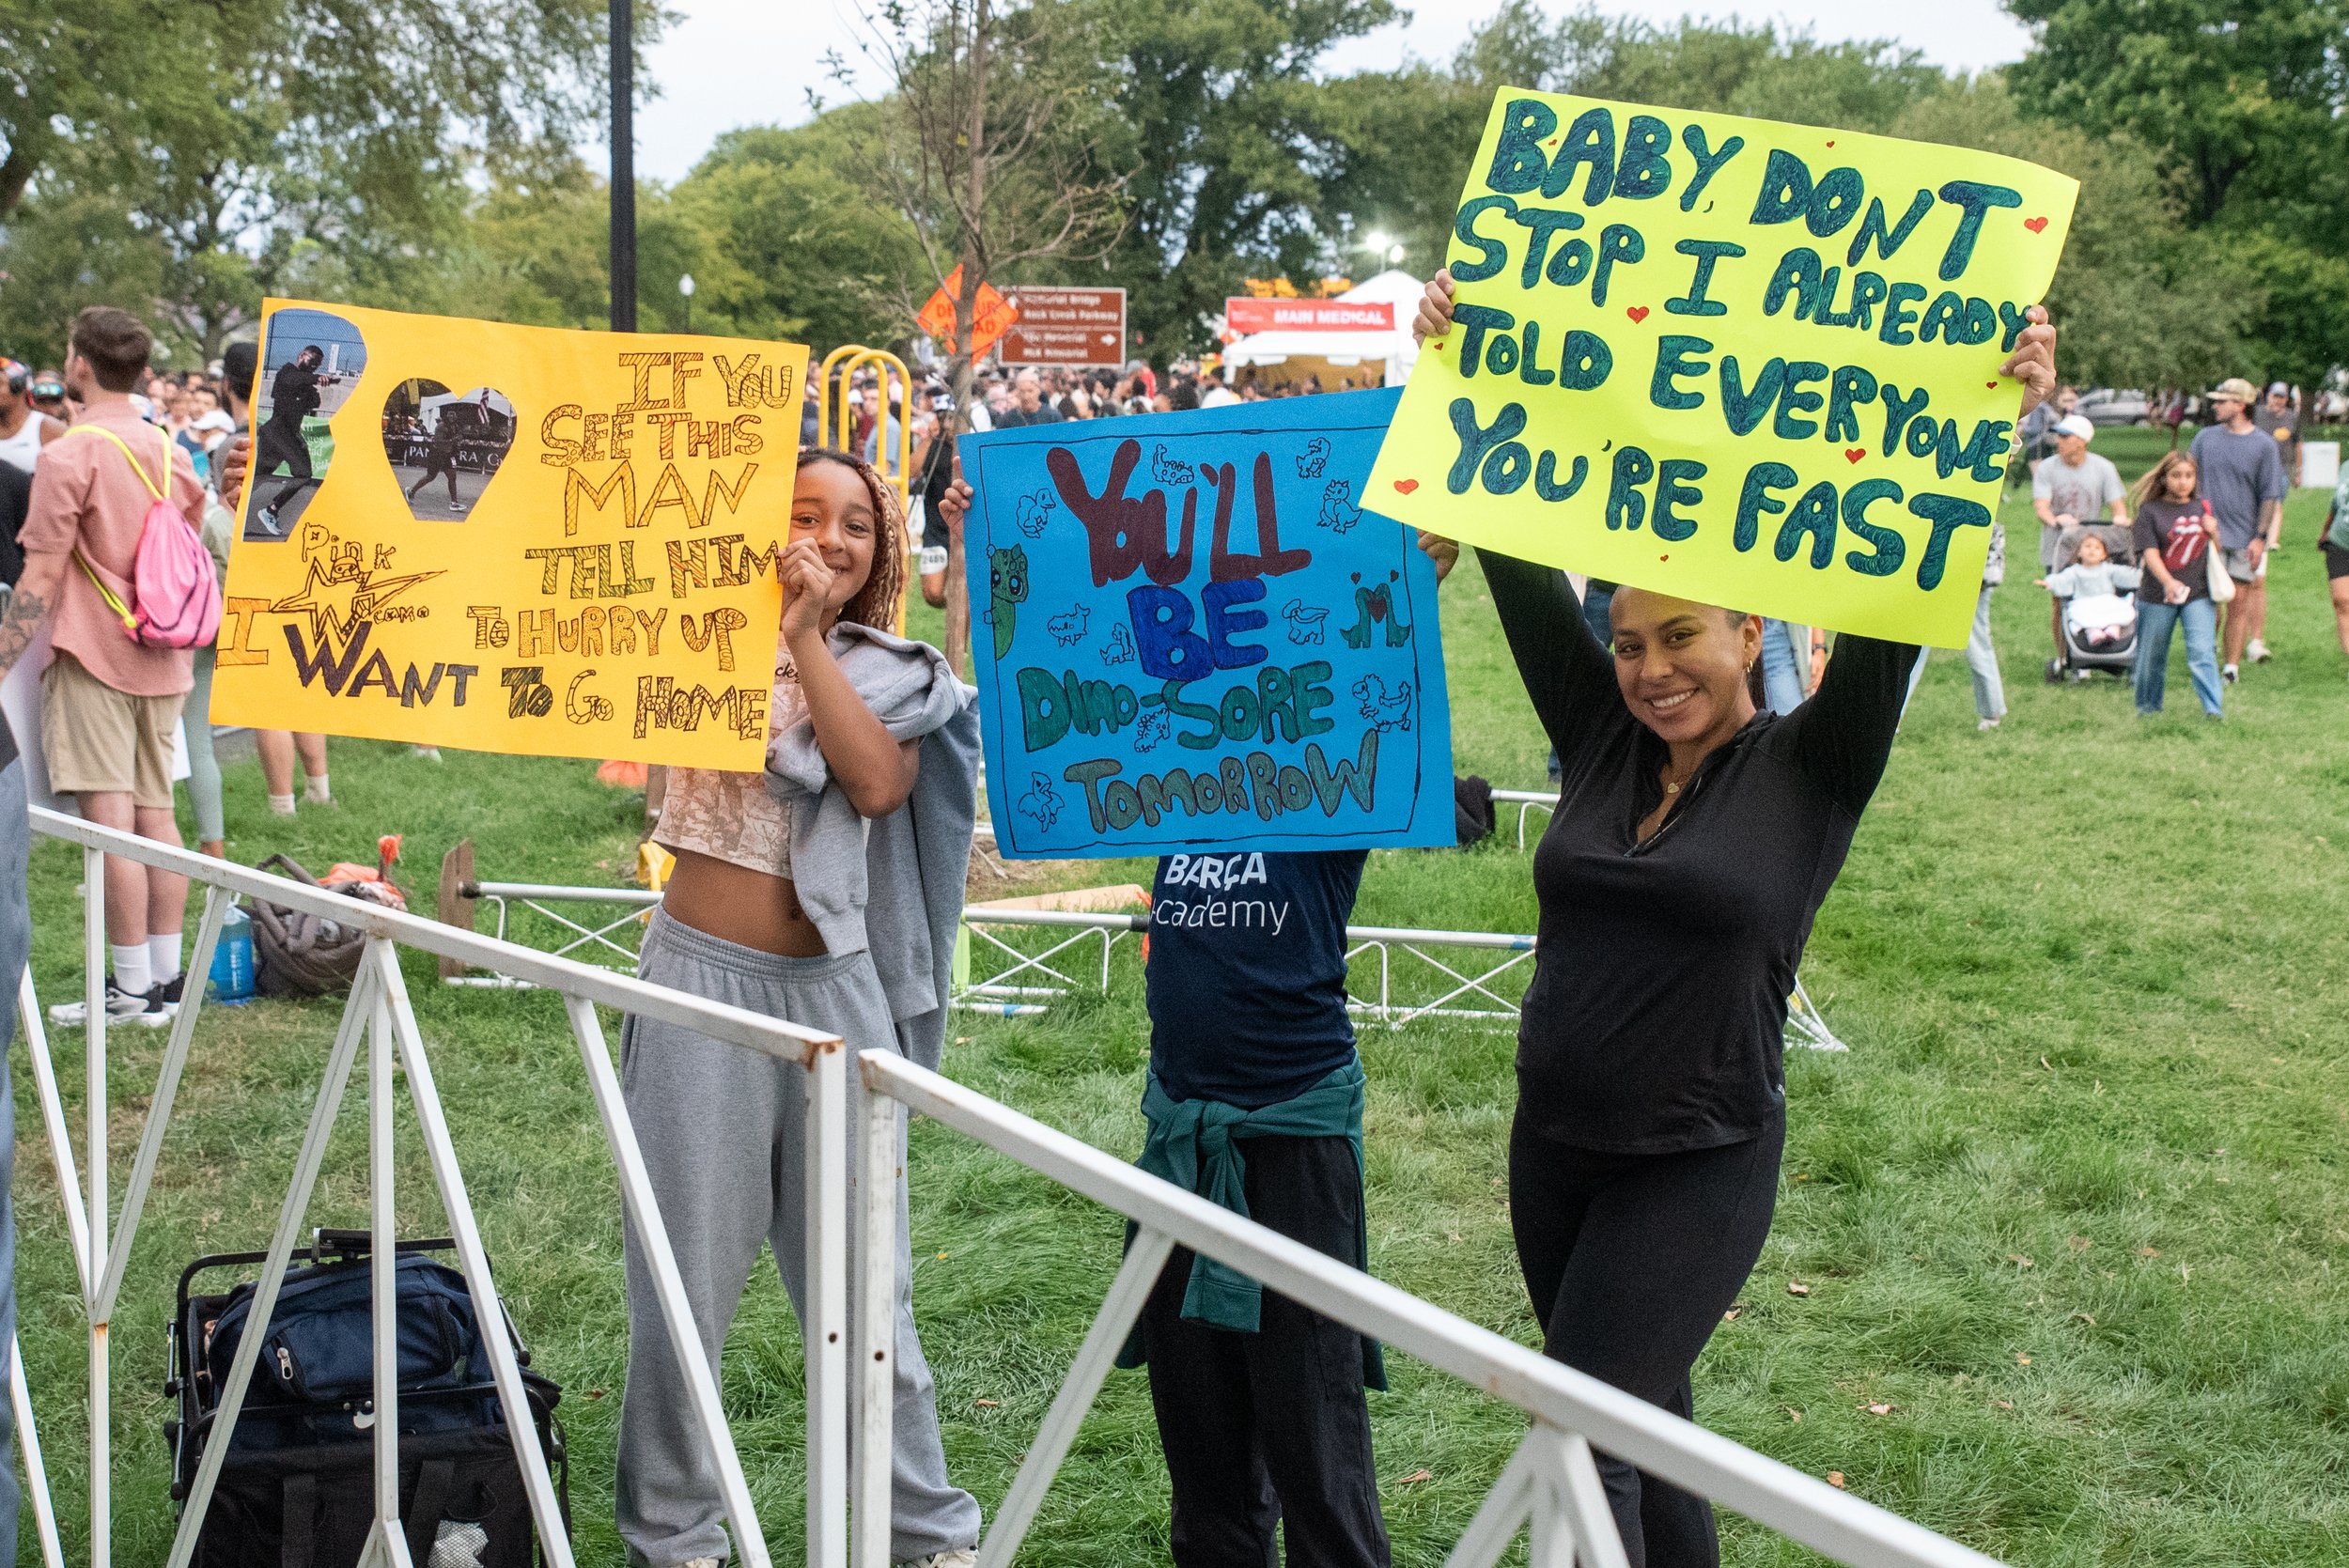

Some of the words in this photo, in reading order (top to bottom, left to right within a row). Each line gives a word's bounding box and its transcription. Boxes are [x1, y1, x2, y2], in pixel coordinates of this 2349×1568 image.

[1749, 147, 2023, 282] DONT
[1448, 194, 1646, 308] STOP
[1663, 239, 1747, 318] I
[1762, 246, 2031, 354] ALREADY
[1274, 310, 1314, 324] MAIN
[1316, 310, 1386, 325] MEDICAL
[617, 352, 703, 412] IF
[713, 352, 791, 409] YOU
[1451, 303, 1613, 392] TOLD
[1650, 334, 2014, 483] EVERYONE
[540, 404, 634, 467] SEE
[646, 412, 763, 459] THIS
[565, 460, 758, 537] MAN
[1446, 397, 1709, 543] YOU'RE
[1733, 460, 1993, 593] FAST
[525, 539, 655, 598] TELL
[665, 534, 781, 598] HIM
[216, 597, 271, 666] I
[284, 621, 478, 708] WANT
[633, 675, 767, 740] HOME
[518, 605, 668, 658] HURRY
[681, 606, 747, 671] UP
[1127, 578, 1268, 682] BE
[1163, 852, 1267, 892] BARÇA
